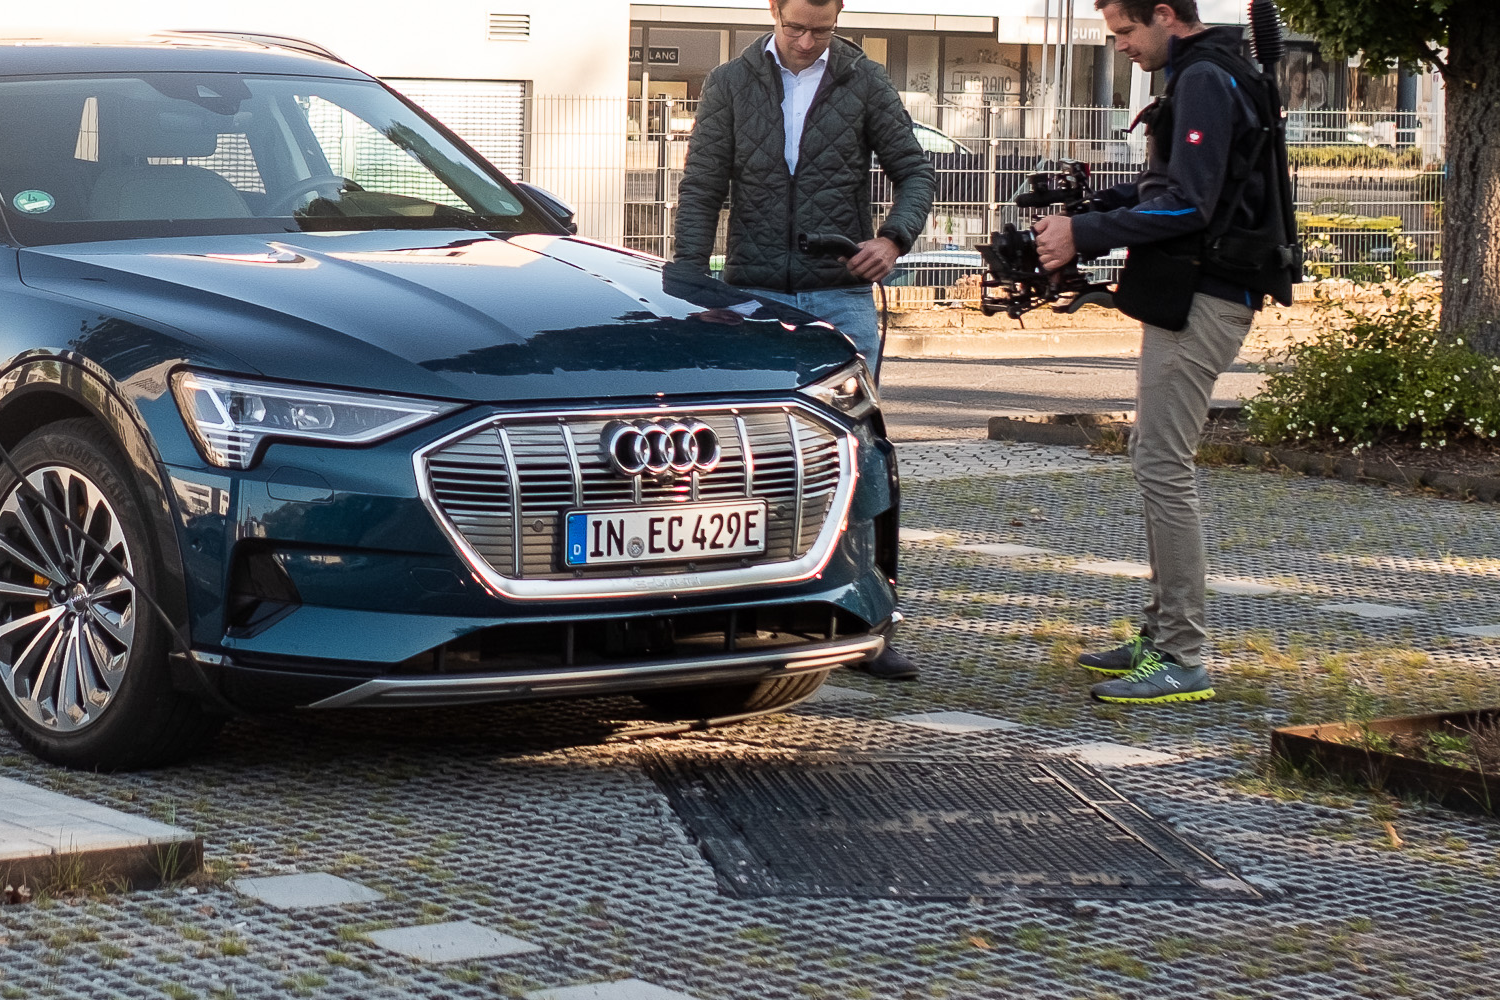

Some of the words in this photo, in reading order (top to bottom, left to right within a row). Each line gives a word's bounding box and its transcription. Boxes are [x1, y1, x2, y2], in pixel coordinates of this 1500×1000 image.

[649, 51, 676, 60] LANG
[589, 518, 625, 558] IN
[648, 516, 684, 554] EC
[691, 510, 760, 551] 429E
[573, 544, 582, 556] D
